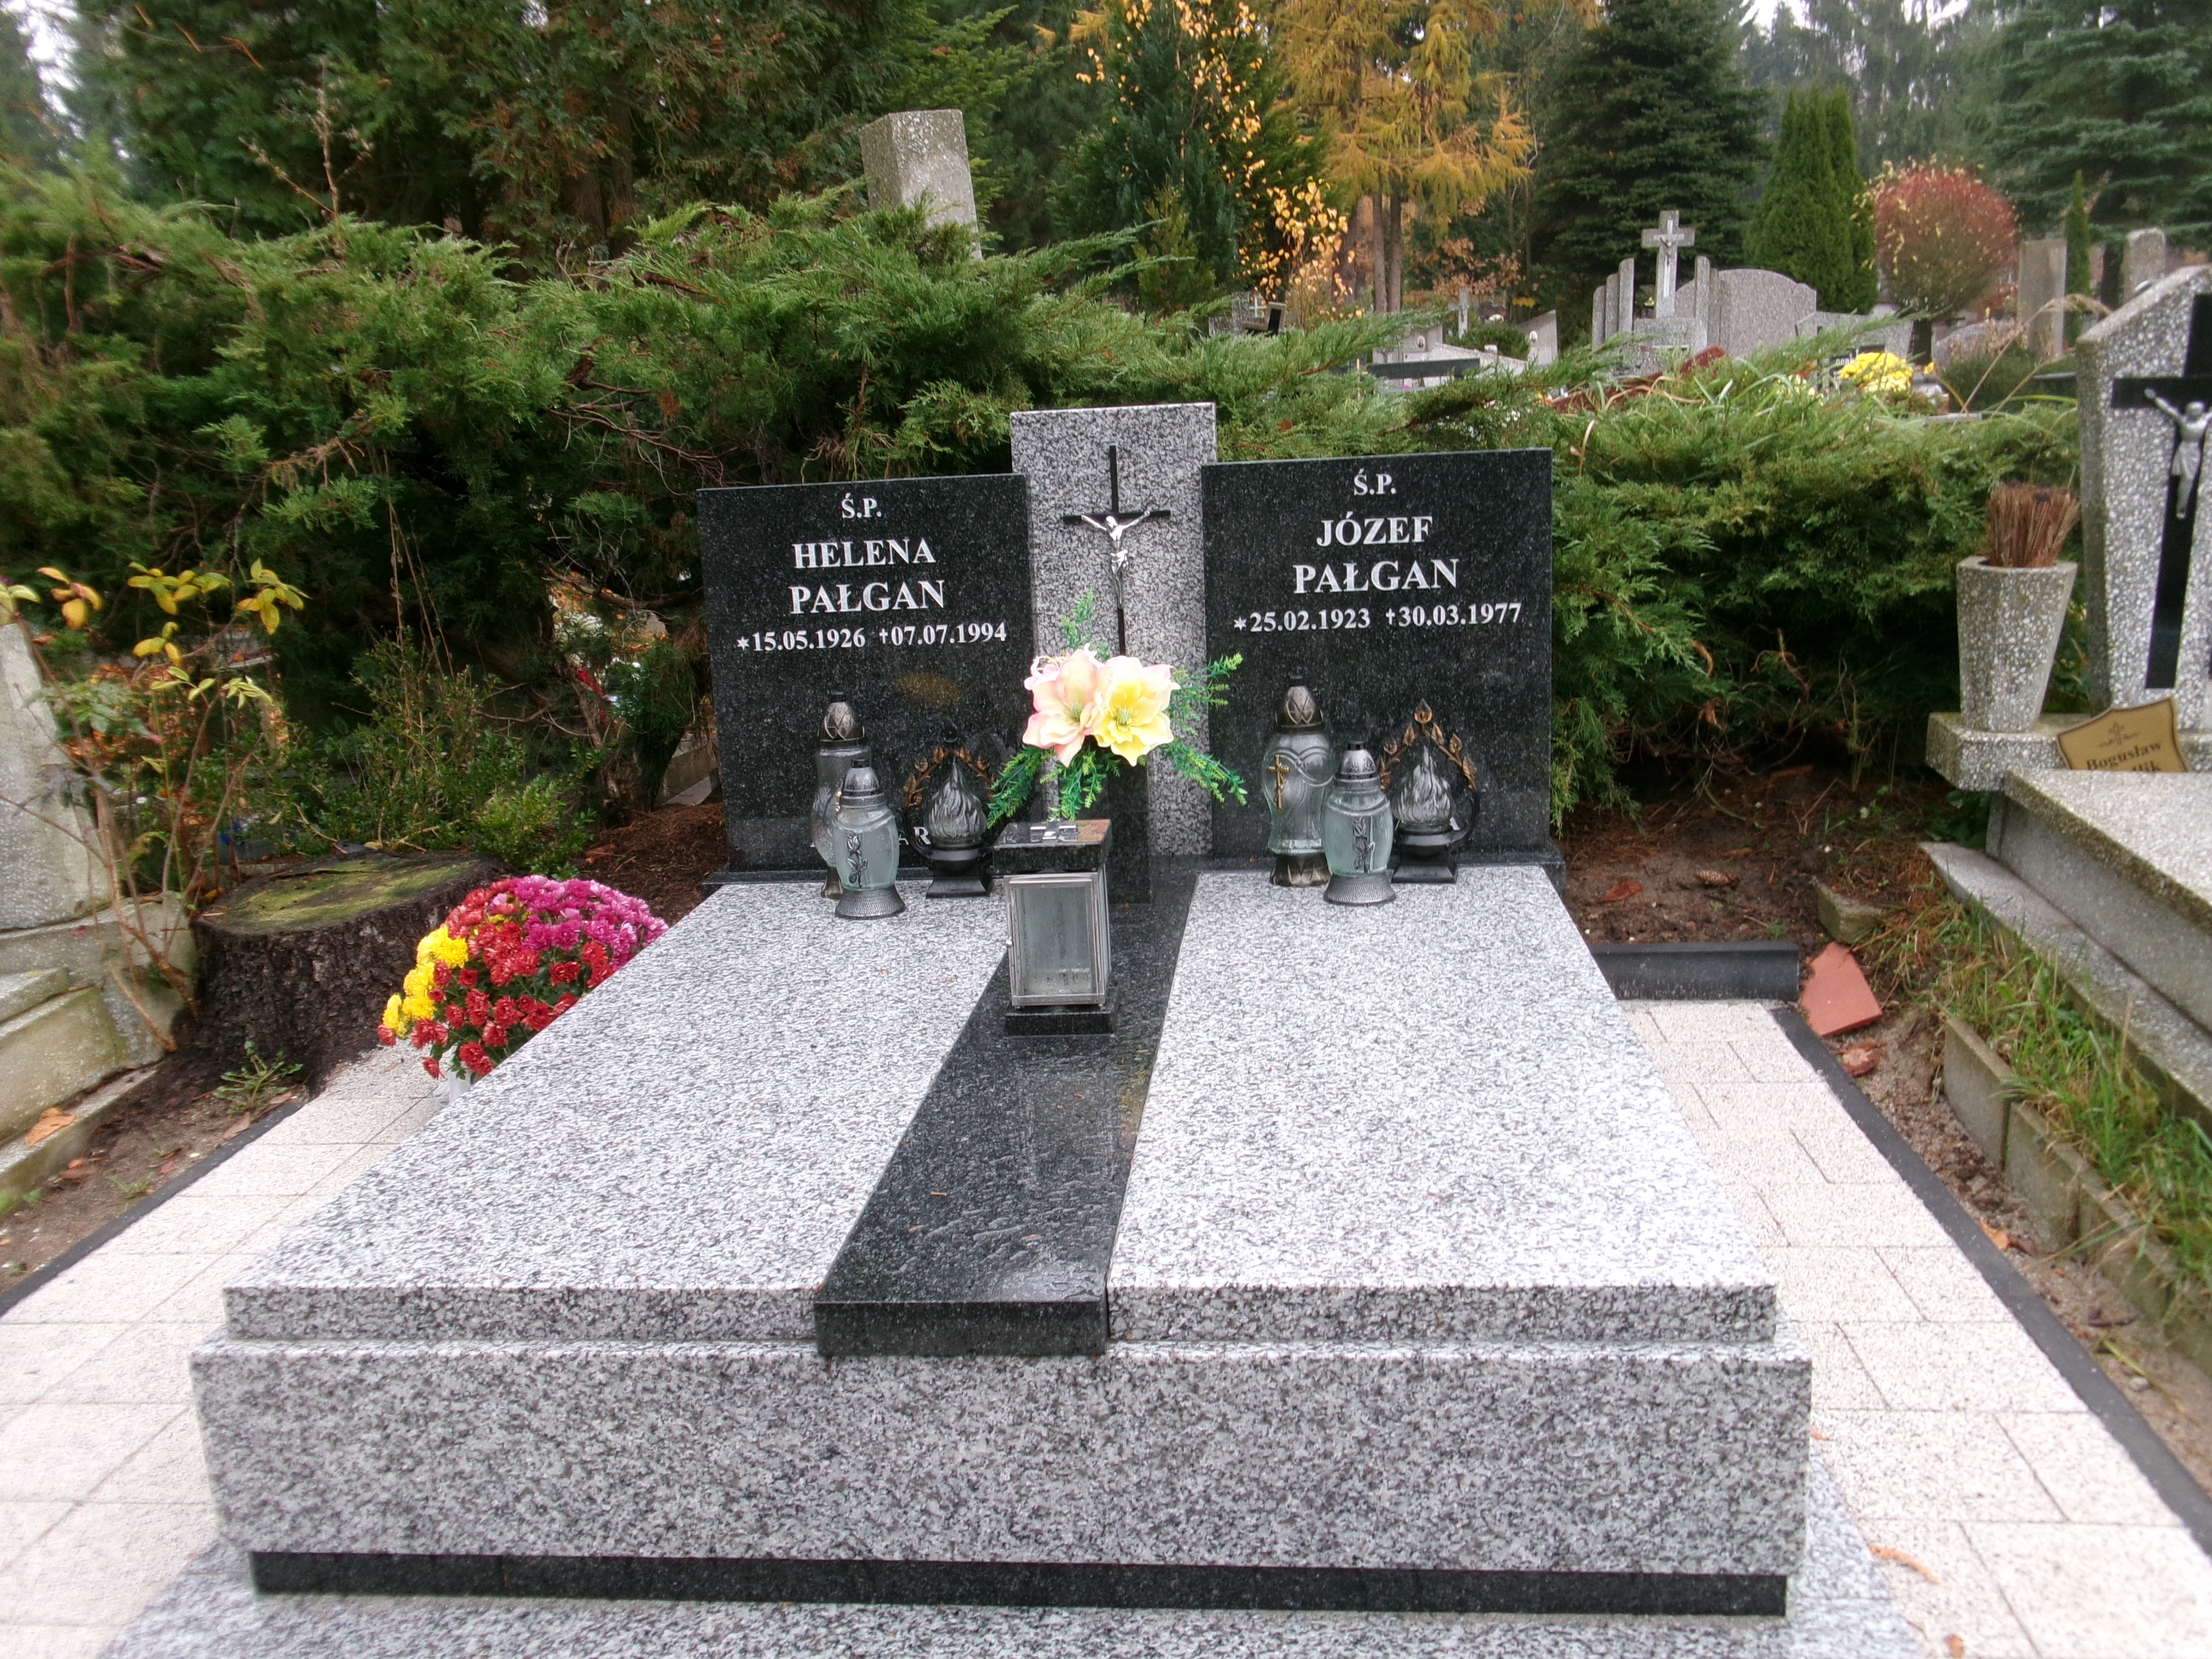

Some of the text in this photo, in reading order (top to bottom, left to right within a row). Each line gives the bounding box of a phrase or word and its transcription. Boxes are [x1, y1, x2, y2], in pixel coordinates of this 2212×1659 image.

[1354, 469, 1396, 495] Ś.P.
[842, 493, 882, 518] Ś.P.
[1317, 511, 1433, 547] JÓZEF
[793, 538, 936, 569] HELENA
[1293, 559, 1459, 594] PAŁGAN
[789, 579, 945, 614] PAŁGAN
